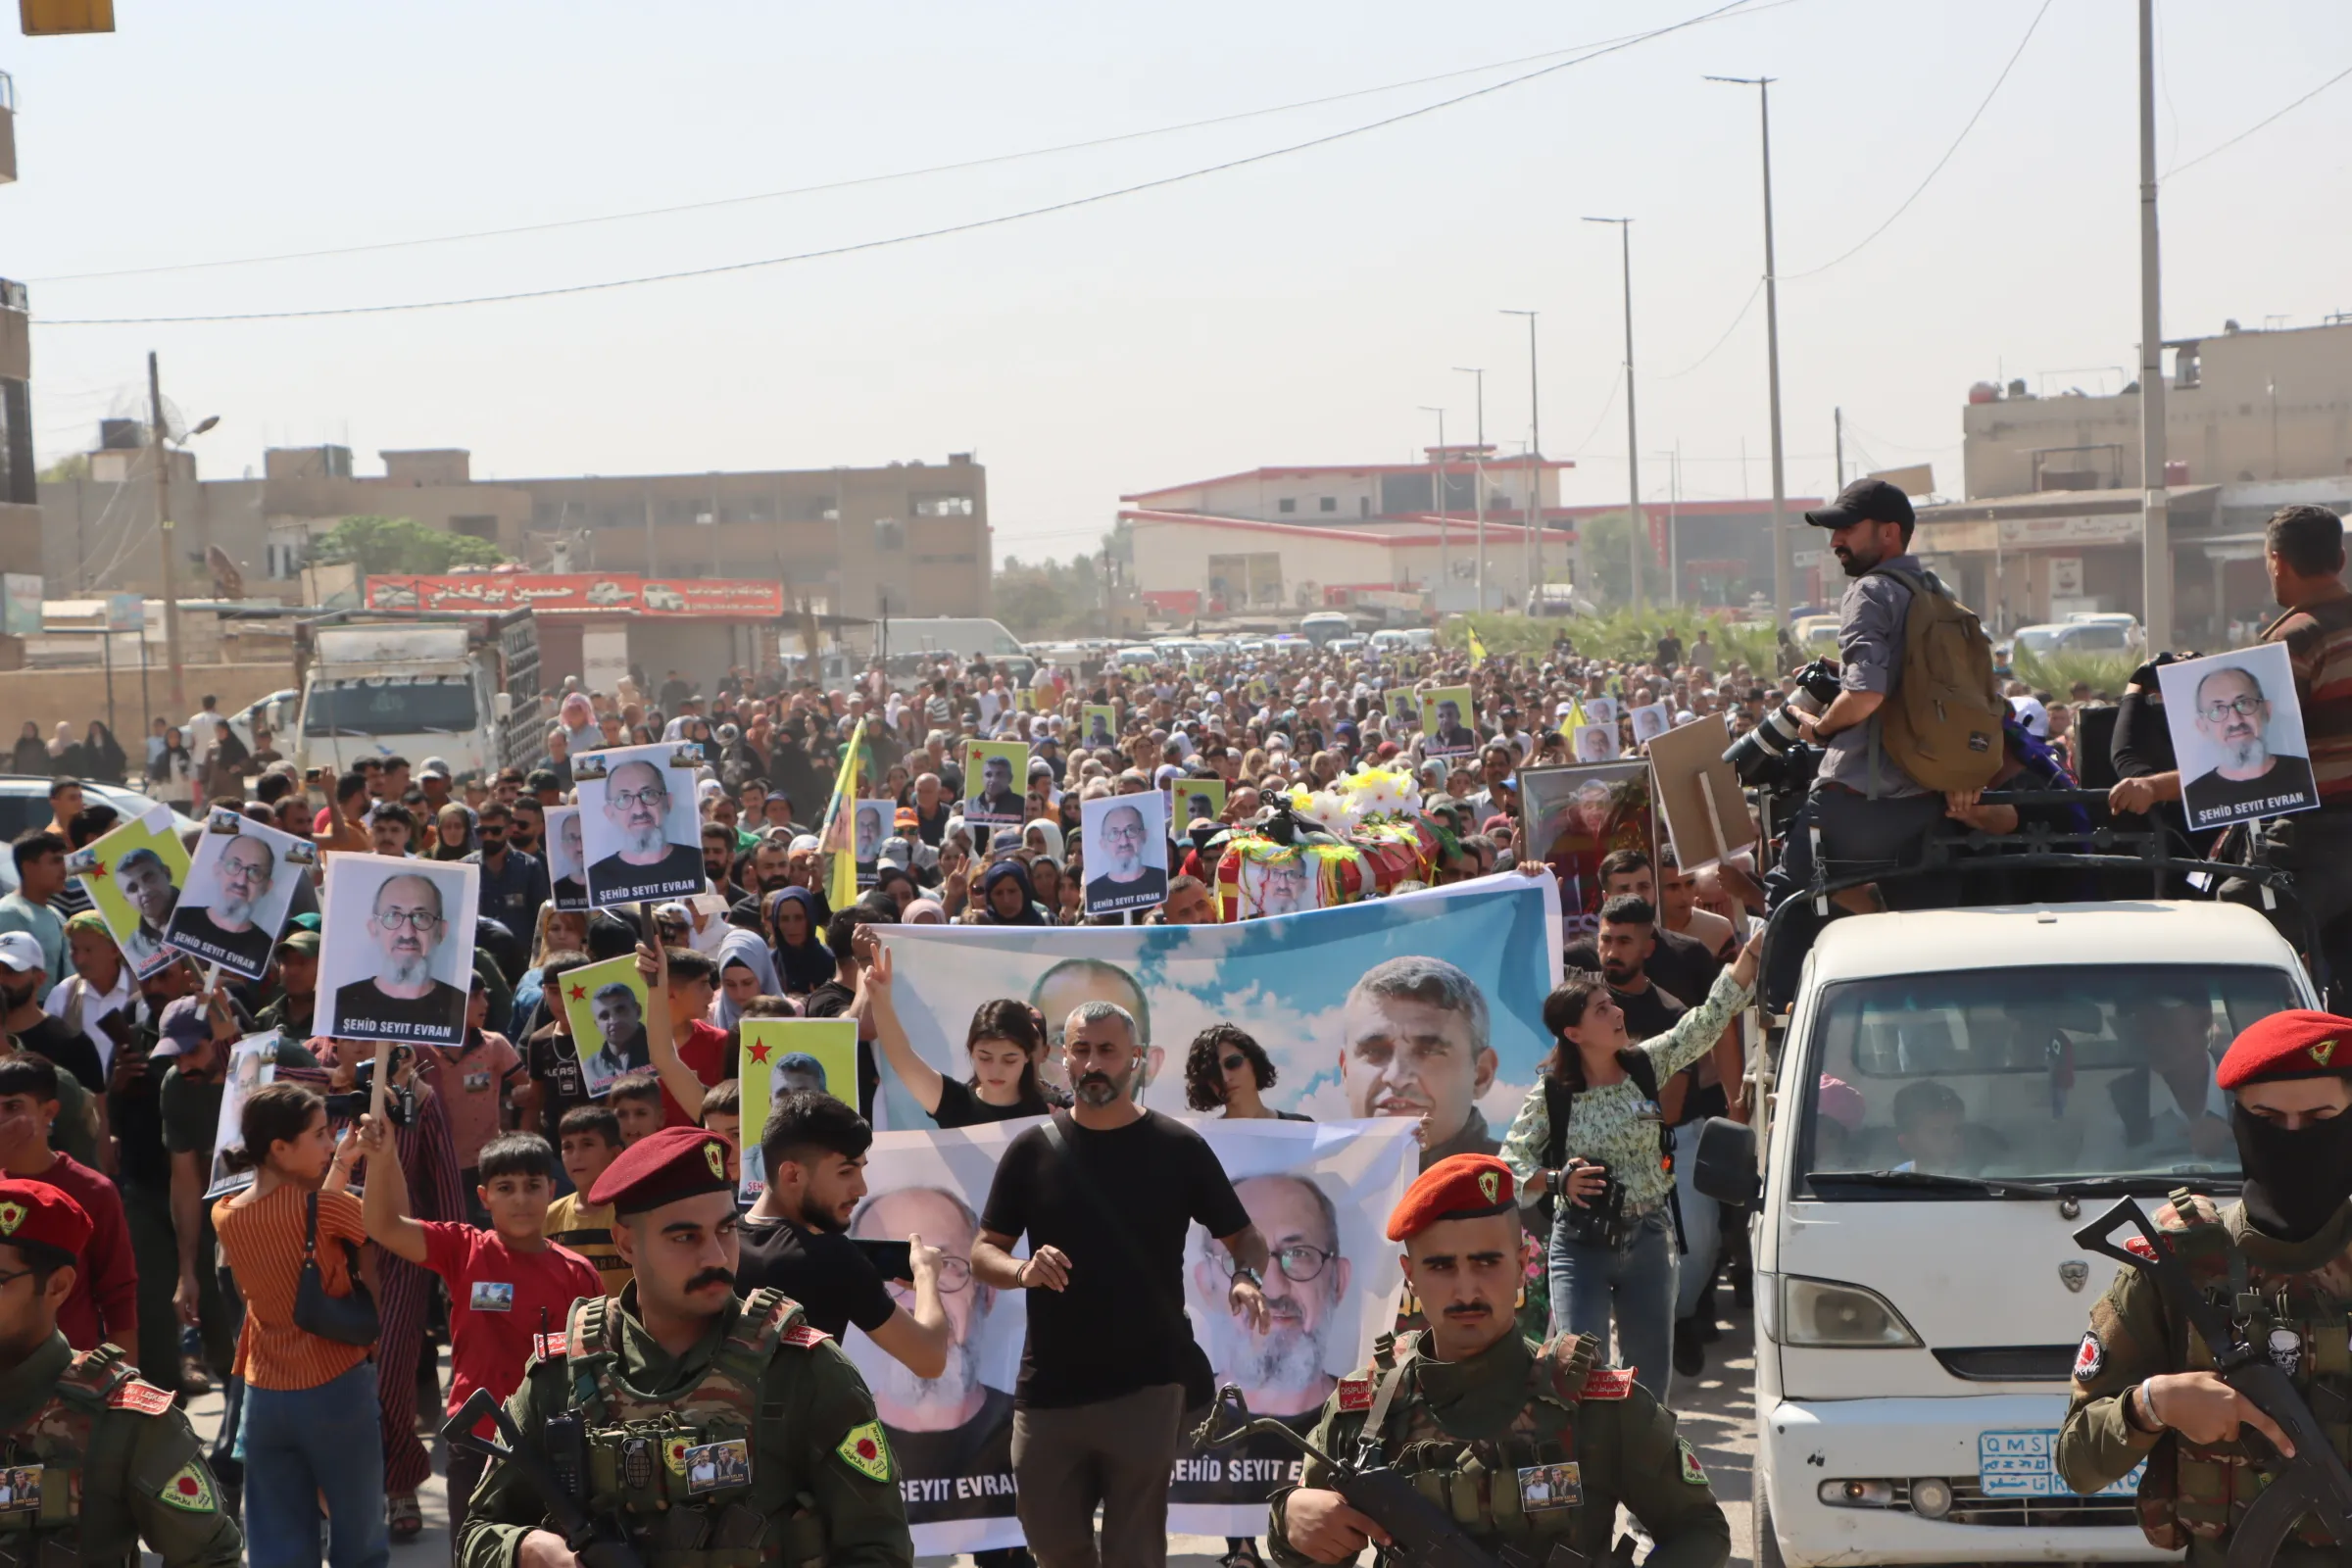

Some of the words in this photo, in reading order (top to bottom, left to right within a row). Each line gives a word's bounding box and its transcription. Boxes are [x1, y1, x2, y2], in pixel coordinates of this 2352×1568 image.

[2234, 799, 2265, 814] SEYIT
[2267, 792, 2305, 808] EVRAN
[632, 884, 659, 897] SEYIT
[662, 879, 695, 892] EVRAN
[1136, 892, 1160, 902] EVRAN
[225, 952, 256, 969] EVRAN
[379, 1021, 411, 1034] SEYIT
[414, 1024, 451, 1037] EVRAN
[748, 1182, 764, 1195] ŞEH
[1228, 1458, 1284, 1482] SEYIT
